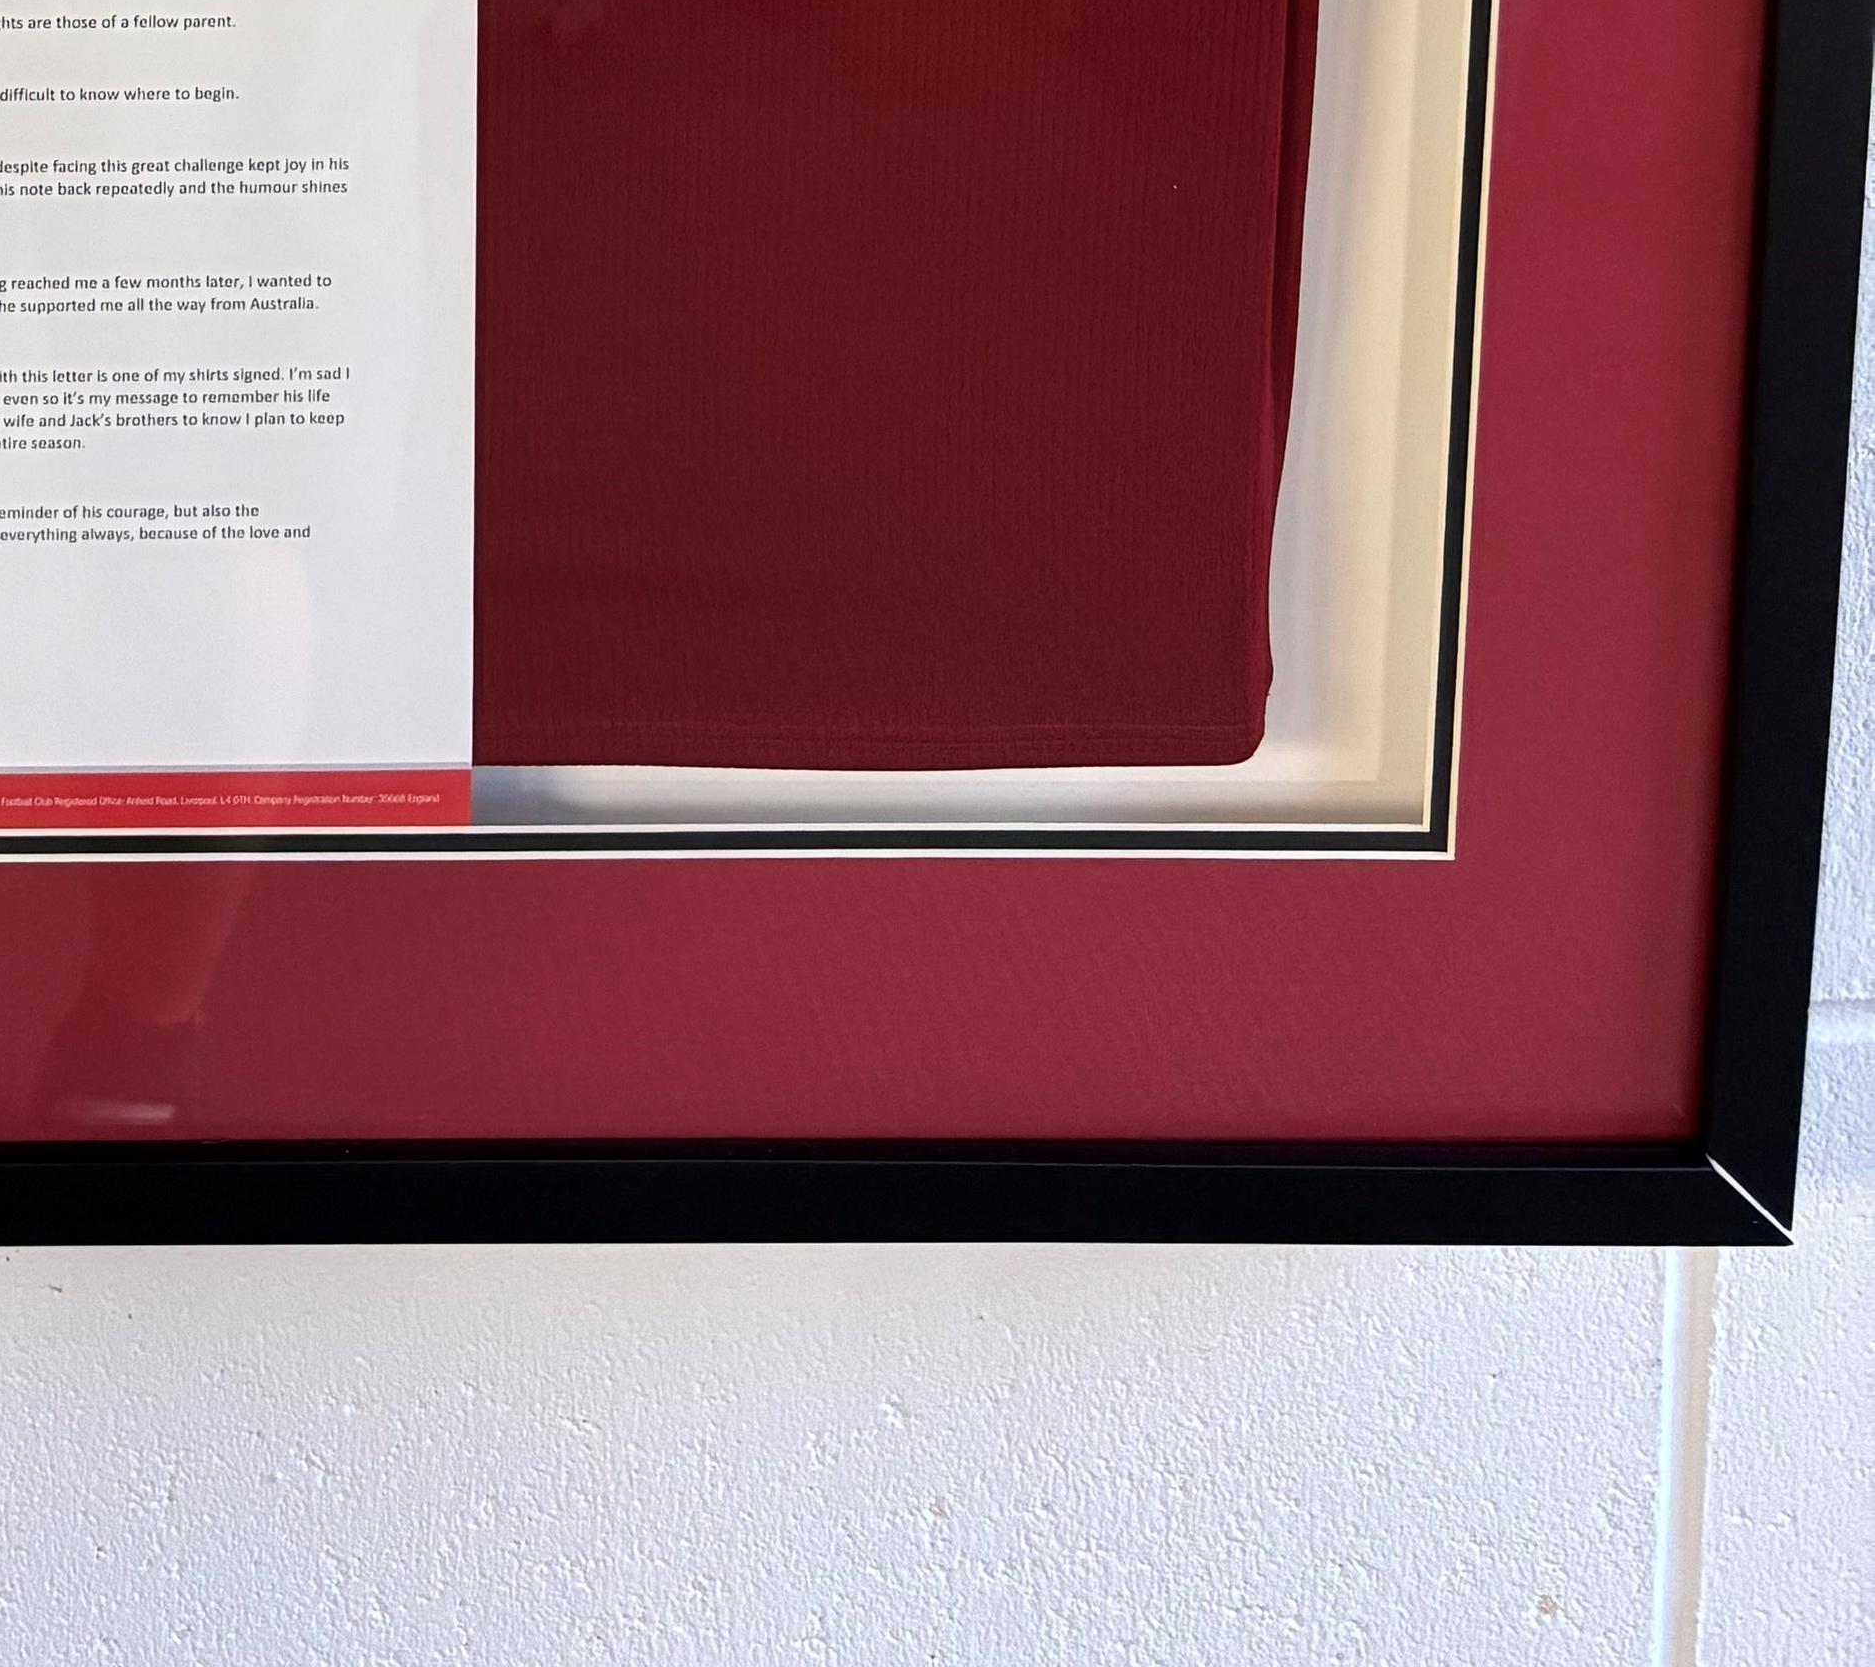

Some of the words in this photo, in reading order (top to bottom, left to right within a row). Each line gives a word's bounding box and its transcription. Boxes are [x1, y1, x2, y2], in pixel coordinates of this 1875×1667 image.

[20, 298, 95, 315] supported
[100, 301, 126, 312] me
[127, 297, 145, 311] all
[149, 298, 173, 311] the
[177, 301, 206, 314] way
[209, 297, 246, 311] from
[250, 296, 319, 311] Australia.
[31, 439, 85, 449] season.
[0, 528, 77, 544] everything
[82, 528, 135, 543] always,
[139, 526, 198, 540] because
[202, 526, 217, 539] of
[221, 526, 245, 539] the
[250, 525, 280, 539] love
[284, 525, 311, 538] and
